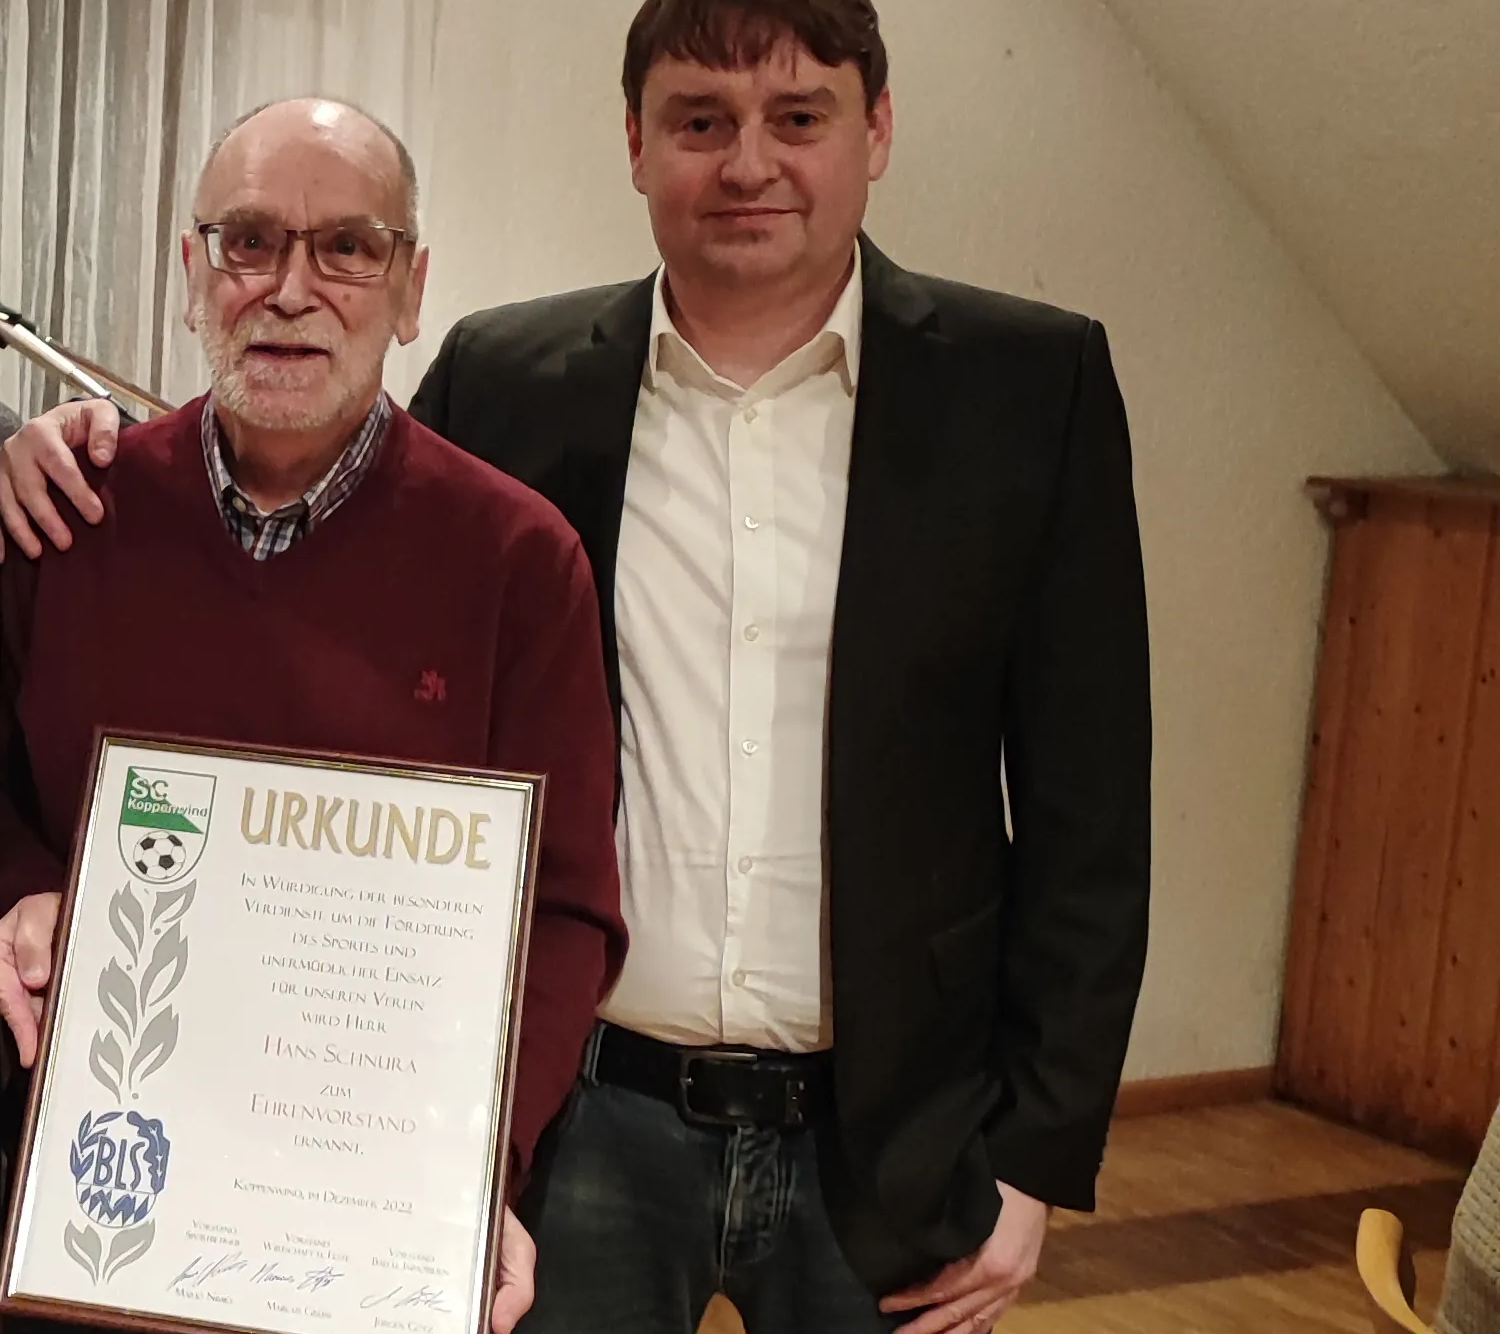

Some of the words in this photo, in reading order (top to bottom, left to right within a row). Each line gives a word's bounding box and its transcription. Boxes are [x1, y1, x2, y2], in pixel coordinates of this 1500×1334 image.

[130, 777, 169, 802] SC
[240, 786, 492, 870] URKUNDE
[384, 944, 417, 958] UND
[264, 1034, 317, 1060] HANS
[320, 1084, 351, 1098] ZUM
